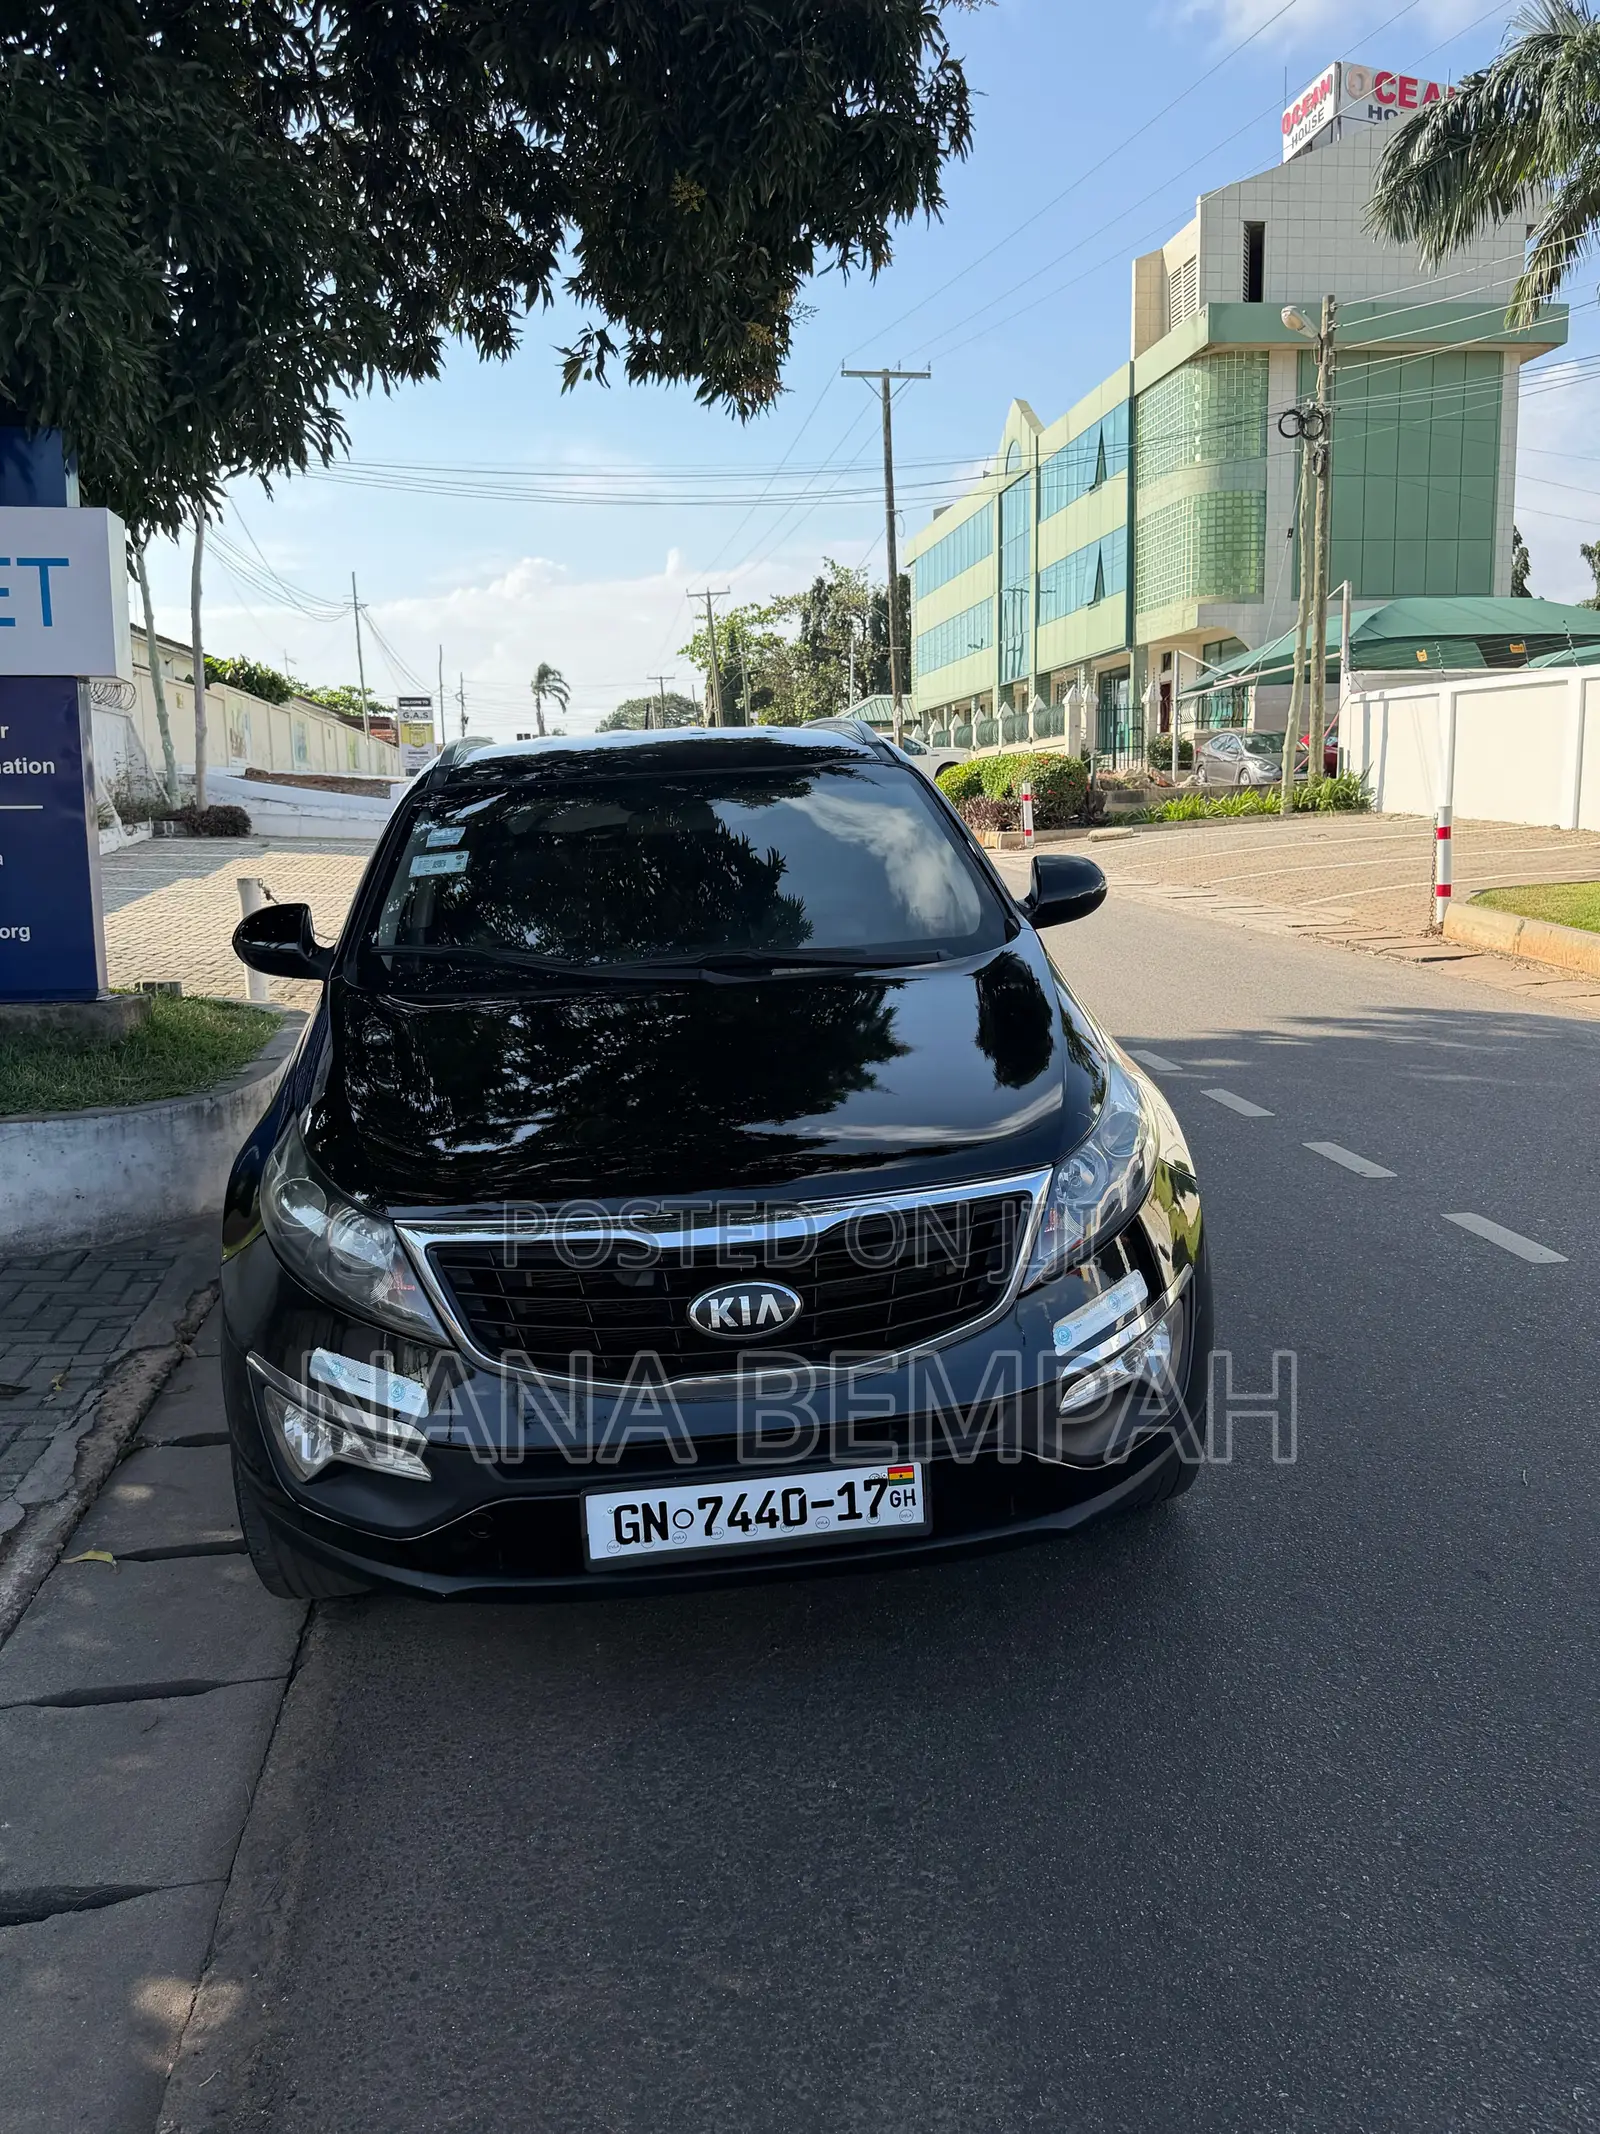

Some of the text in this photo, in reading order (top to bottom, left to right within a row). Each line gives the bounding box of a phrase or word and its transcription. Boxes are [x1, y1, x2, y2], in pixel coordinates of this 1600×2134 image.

[1281, 74, 1333, 134] OCEAN
[1346, 66, 1456, 109] OCEA
[1291, 107, 1325, 149] HOUSE
[402, 711, 429, 719] G.A.S
[0, 757, 55, 774] ation
[708, 1293, 784, 1329] KIA
[697, 1477, 889, 1537] 7440-17
[889, 1488, 917, 1508] GH
